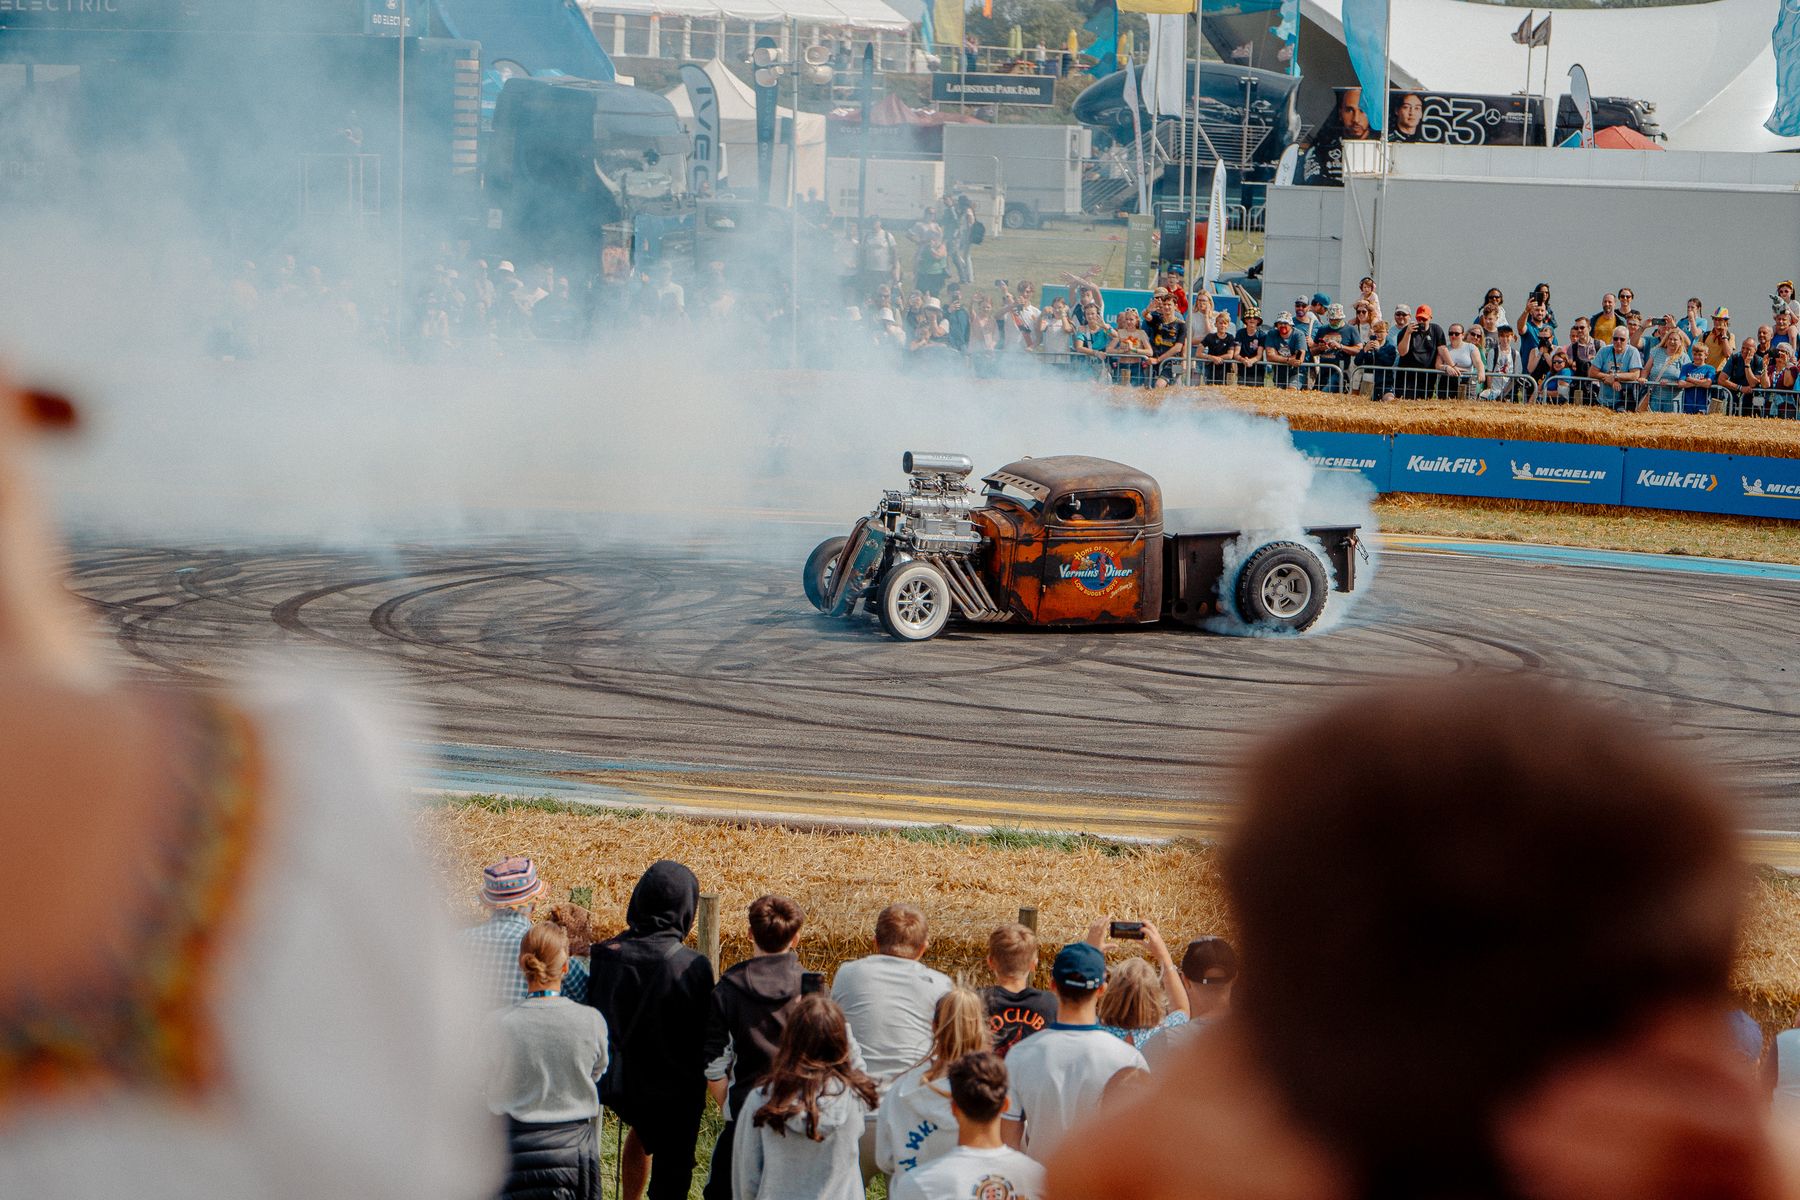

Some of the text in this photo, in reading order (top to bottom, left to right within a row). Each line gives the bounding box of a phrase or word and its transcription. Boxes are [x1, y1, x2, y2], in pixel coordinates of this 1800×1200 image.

[382, 15, 410, 27] ELECTIC
[996, 85, 1017, 94] PARK
[1018, 86, 1040, 95] FARM
[1422, 96, 1486, 145] 63
[1306, 457, 1376, 468] MICHELIN
[1535, 467, 1606, 480] MICHELIN
[1104, 547, 1116, 558] THE
[1104, 563, 1133, 578] Diner
[1003, 1007, 1045, 1030] CLUB
